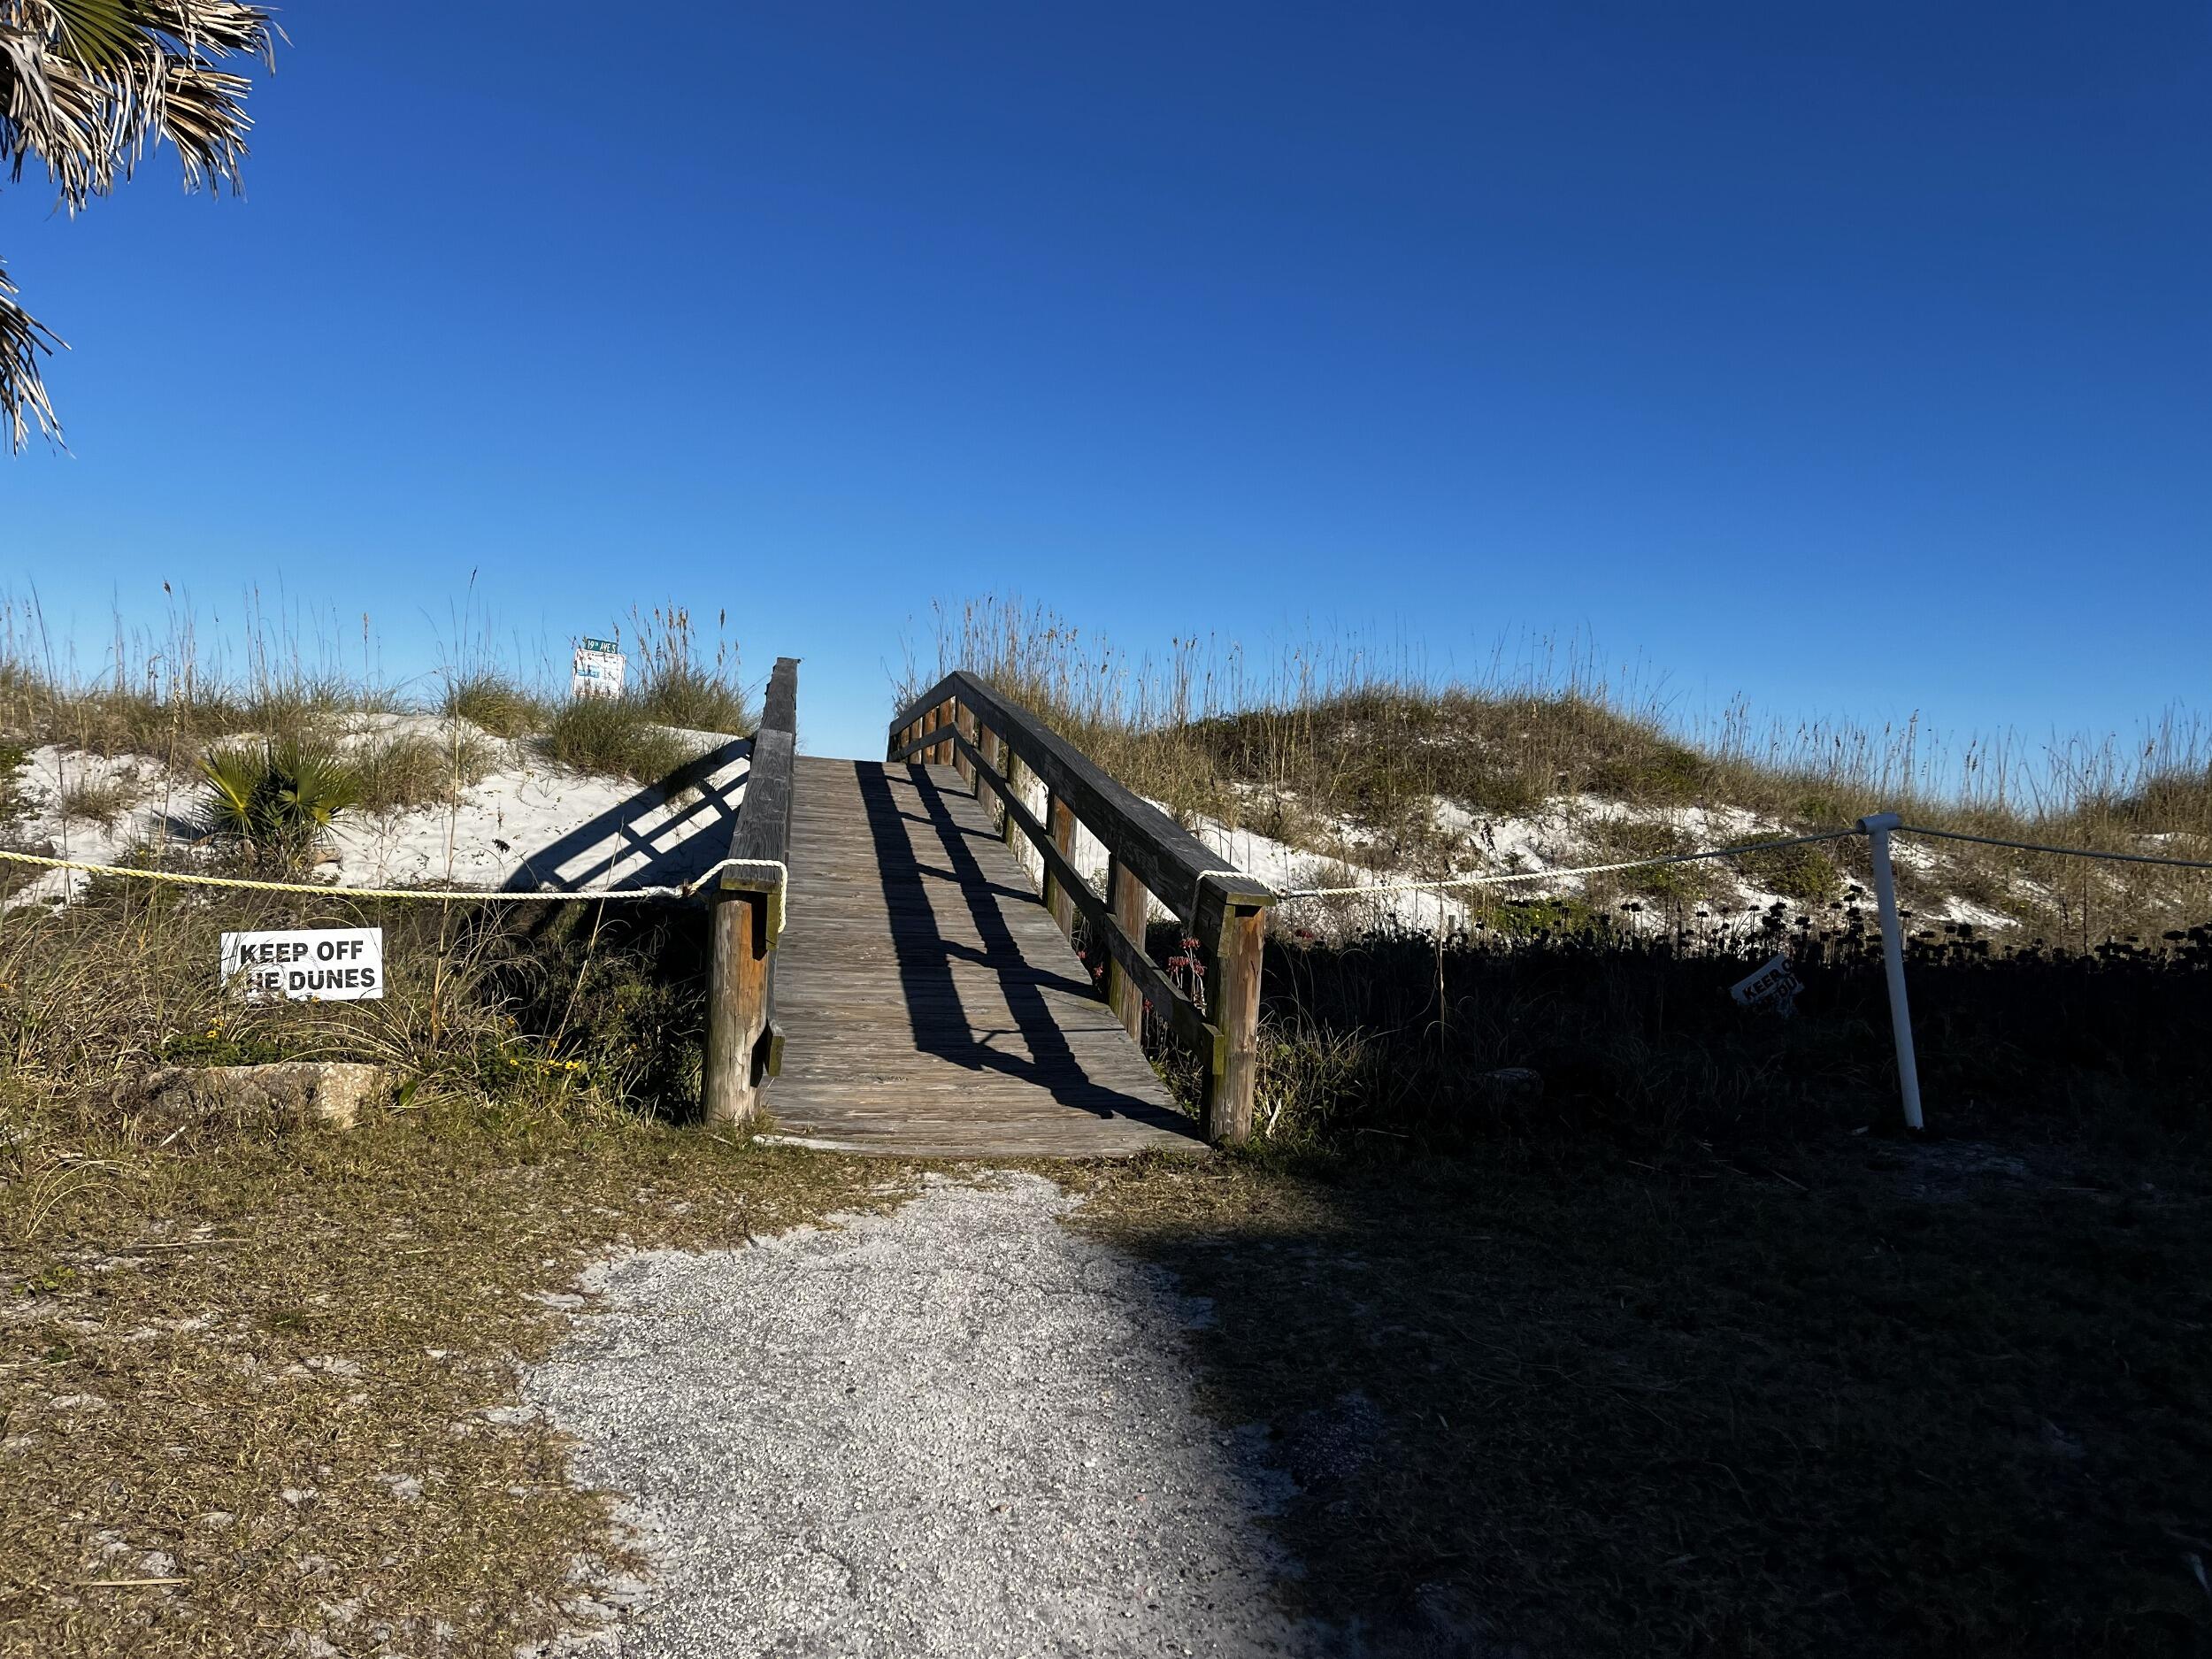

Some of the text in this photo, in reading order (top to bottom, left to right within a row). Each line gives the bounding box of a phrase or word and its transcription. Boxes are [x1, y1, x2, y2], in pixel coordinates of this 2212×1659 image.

[600, 641, 611, 652] AVE
[612, 644, 617, 653] S
[240, 940, 364, 964] KEEP OFF
[240, 967, 375, 992] HE DUNES
[1742, 967, 1780, 999] KEEP
